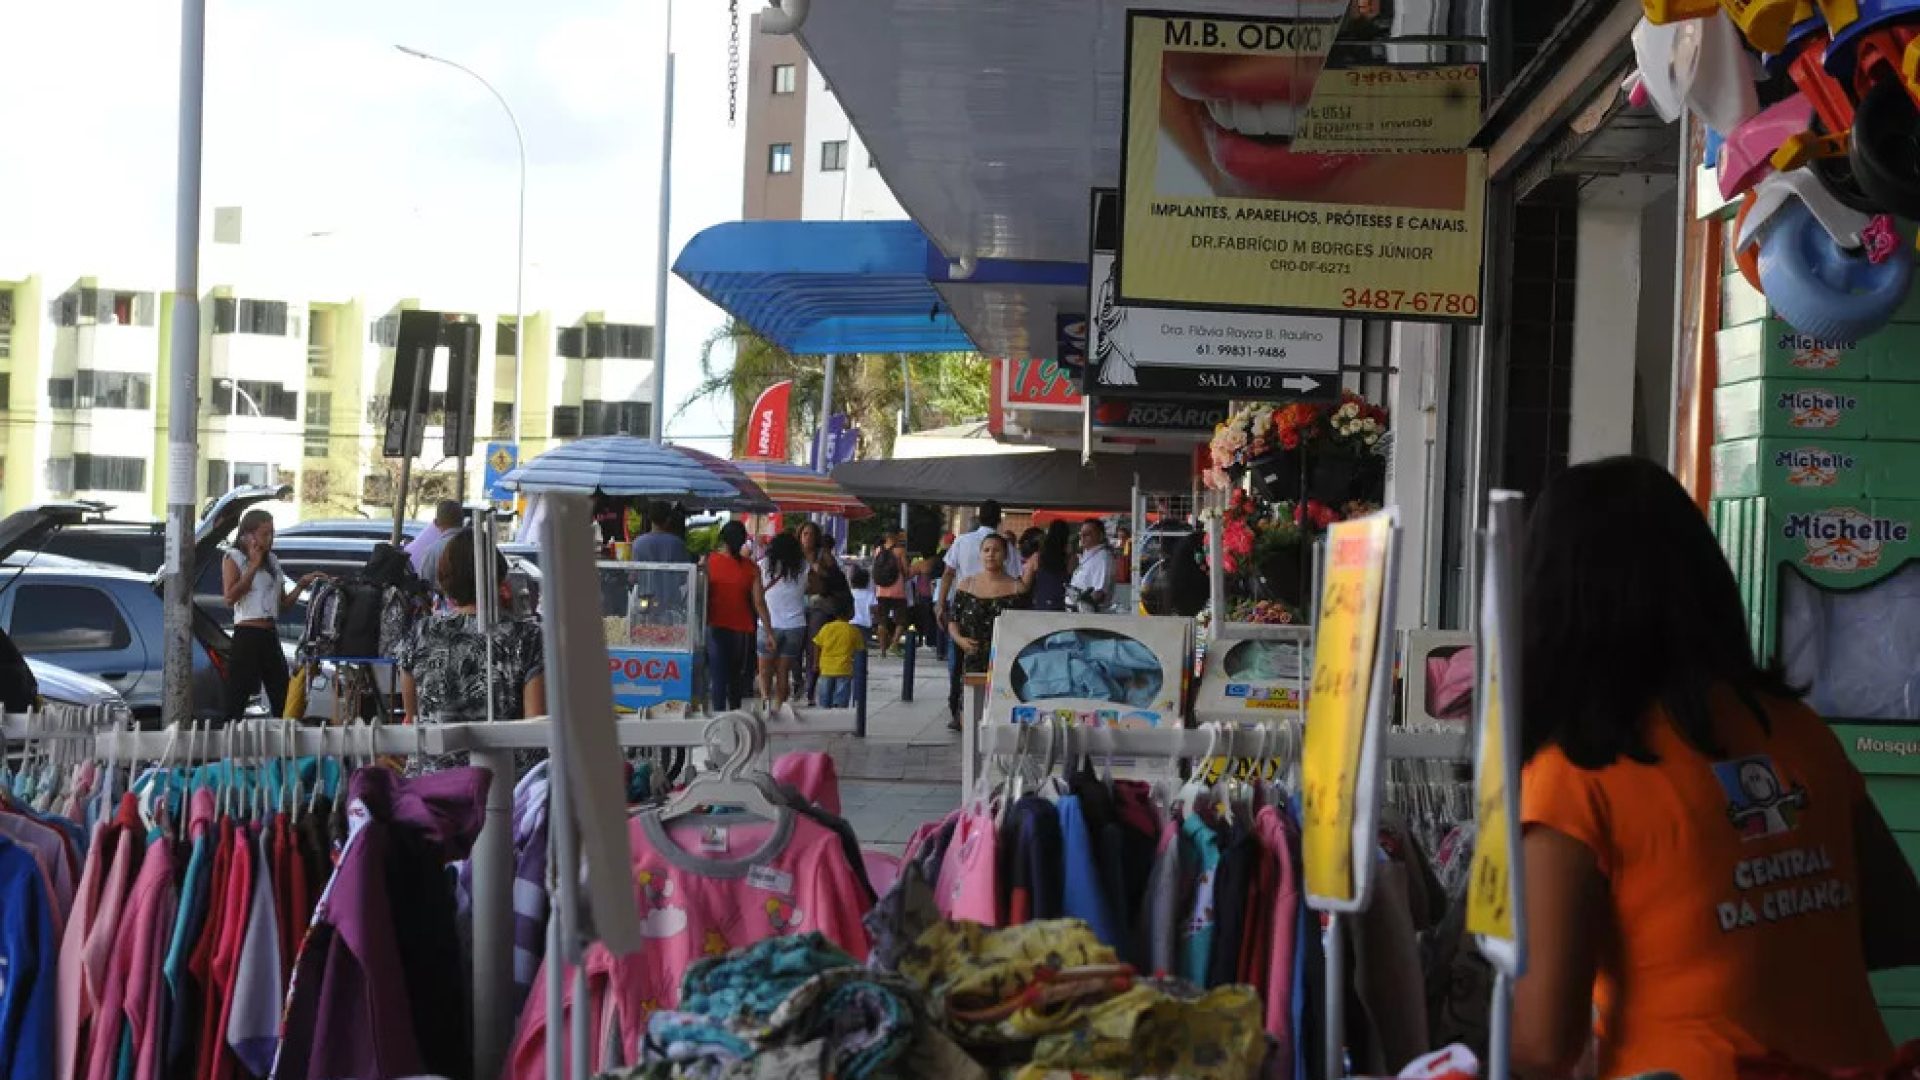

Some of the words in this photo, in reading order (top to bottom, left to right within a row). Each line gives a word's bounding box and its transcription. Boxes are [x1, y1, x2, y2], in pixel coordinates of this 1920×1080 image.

[1164, 21, 1226, 48] M.B.
[1150, 203, 1231, 220] IMPLANTES,
[1235, 207, 1321, 225] APARELHOS,
[1326, 209, 1392, 229] PRÓTESES
[1396, 216, 1404, 229] E
[1408, 216, 1469, 233] CANAIS.
[1293, 240, 1307, 253] M
[1311, 241, 1374, 258] BORGES
[1377, 242, 1434, 260] JÚNIOR
[1269, 259, 1351, 274] CRO-DF-6271
[1341, 287, 1477, 314] 3487-6780
[1160, 323, 1186, 336] Dra.
[1188, 323, 1224, 338] Flávia
[1226, 326, 1264, 341] Rayza
[1266, 327, 1277, 340] B.
[1280, 328, 1324, 342] Raulino
[1196, 344, 1215, 357] 61.
[1217, 344, 1287, 359] 99831-9486
[1198, 372, 1236, 387] SALA
[1245, 375, 1272, 389] 102
[1777, 392, 1857, 410] Michelle
[1775, 450, 1854, 469] Michelle
[1783, 514, 1909, 543] Michelle
[1856, 737, 1920, 756] Mosqu
[1735, 845, 1831, 888] CENTRAL
[1718, 900, 1756, 930] DA
